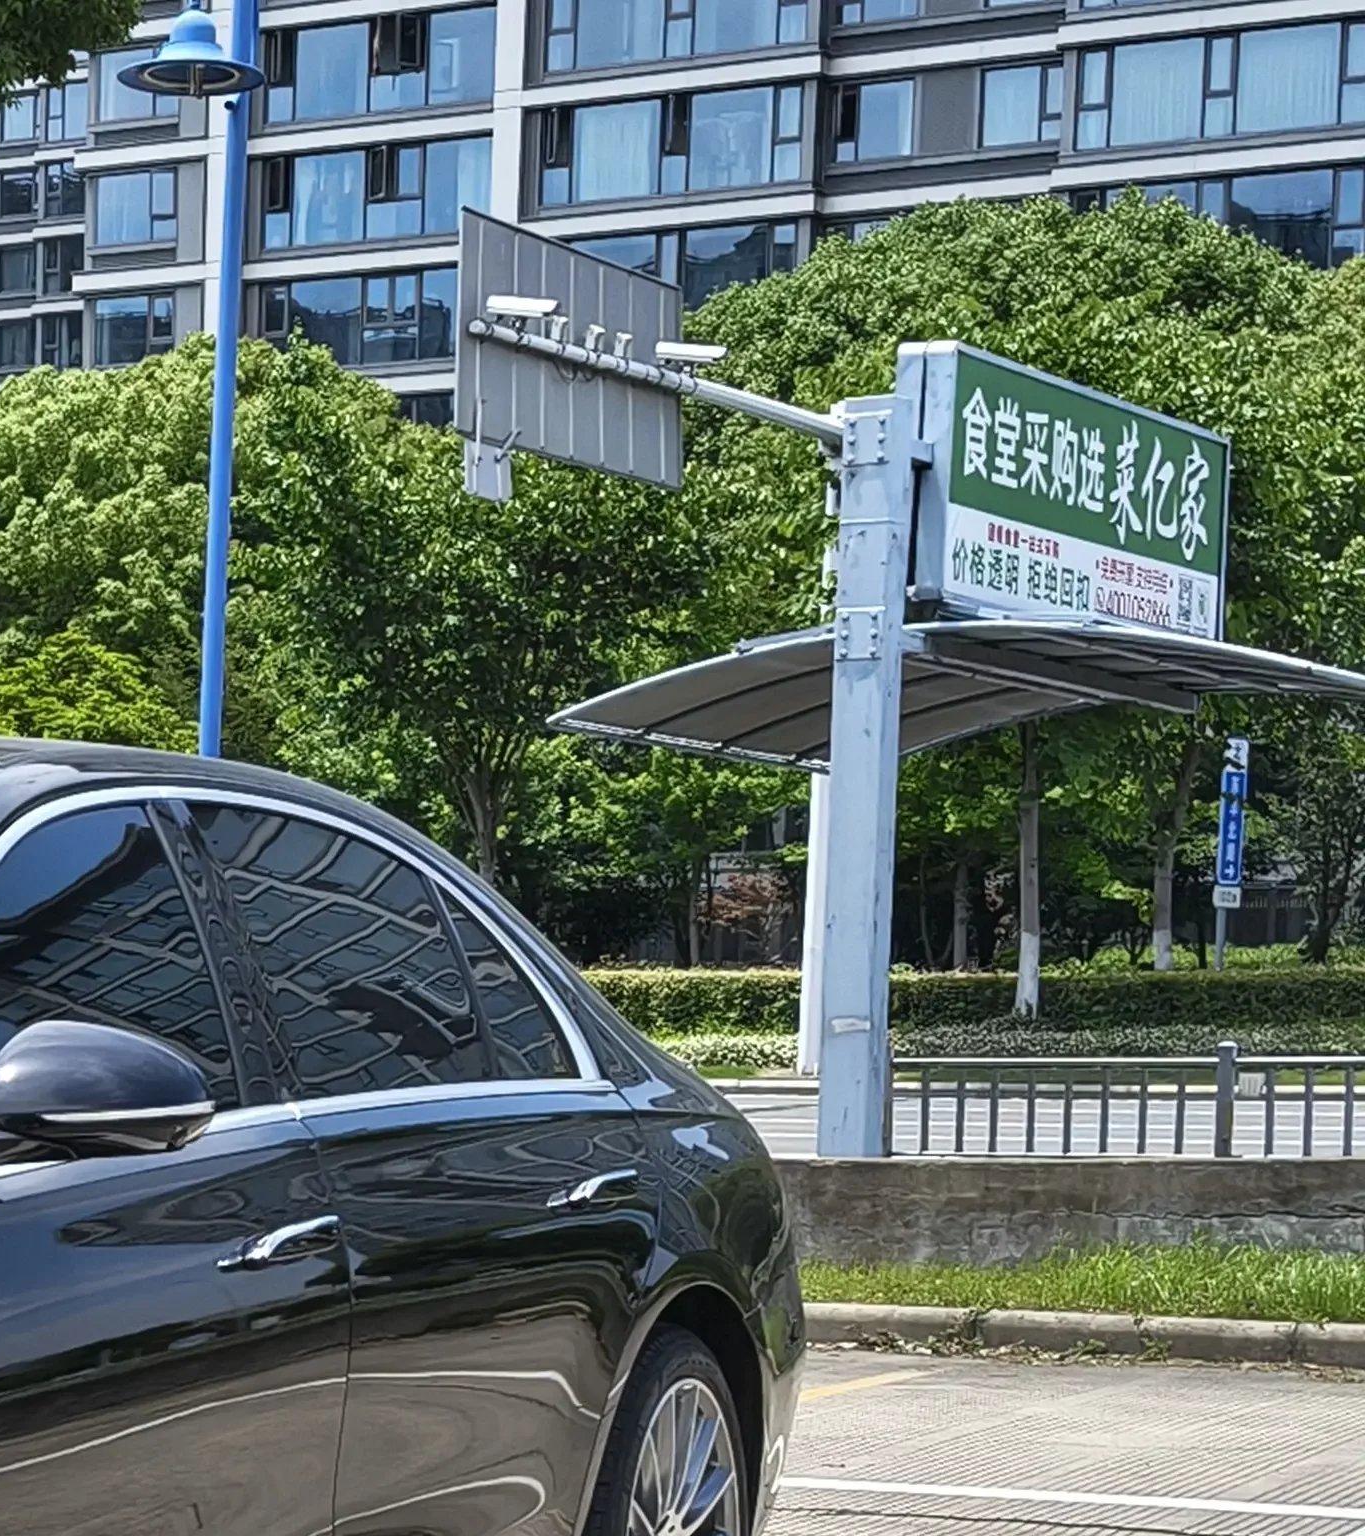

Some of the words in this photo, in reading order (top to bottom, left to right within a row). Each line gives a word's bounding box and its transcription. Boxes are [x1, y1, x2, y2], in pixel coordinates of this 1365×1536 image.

[962, 387, 1210, 561] 食堂采购选菜亿家
[952, 538, 1019, 596] 价格透明
[1027, 558, 1090, 612] 拒绝回扣
